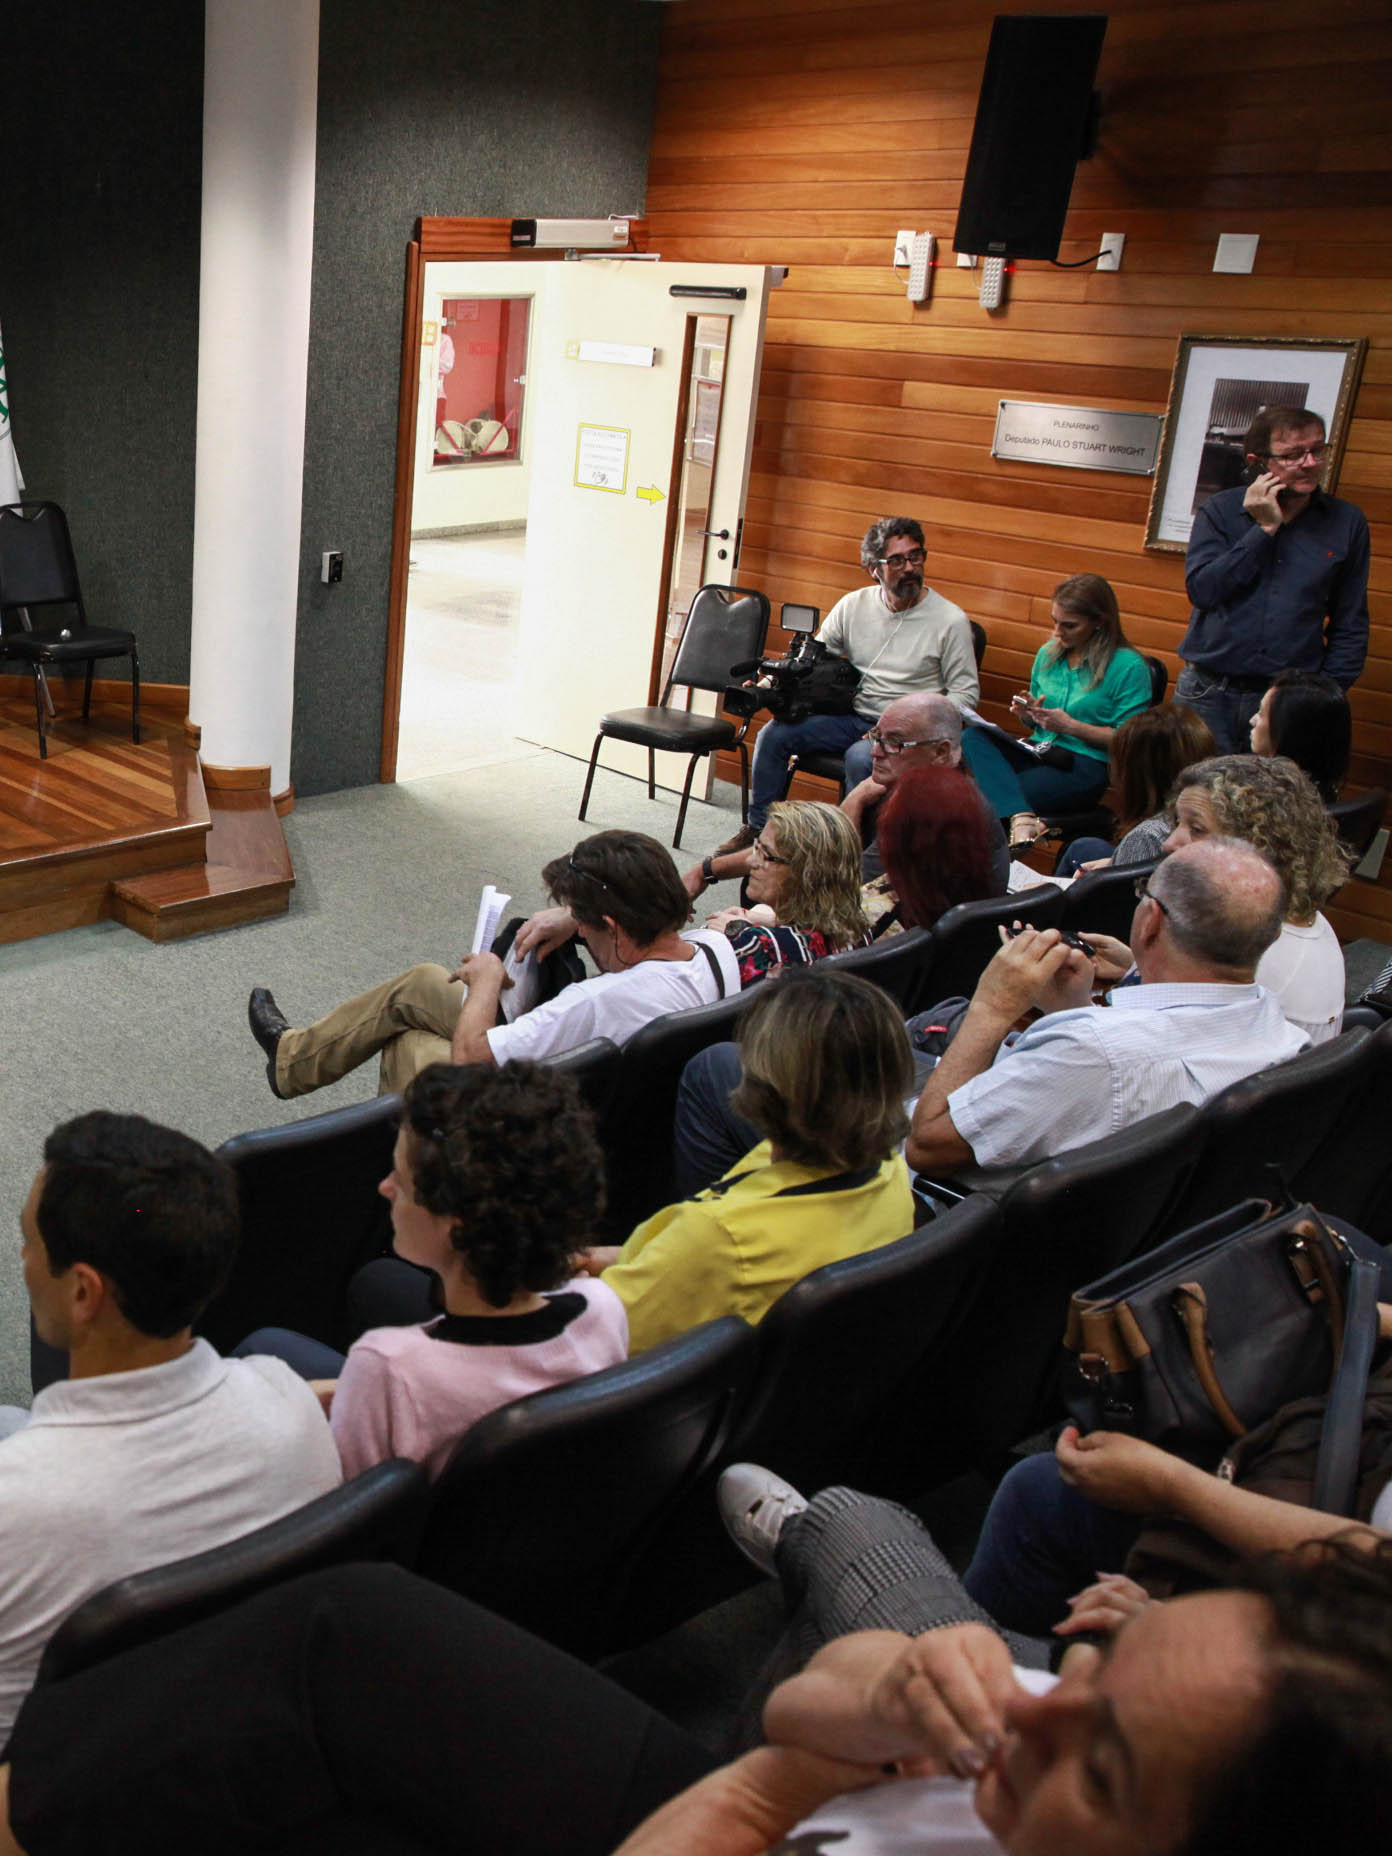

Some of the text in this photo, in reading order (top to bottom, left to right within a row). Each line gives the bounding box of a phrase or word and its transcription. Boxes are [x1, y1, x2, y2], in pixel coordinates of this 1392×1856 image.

[1053, 420, 1100, 432] PLENARINHO
[1004, 433, 1146, 457] Deputado PAULO STUART WRIGHT
